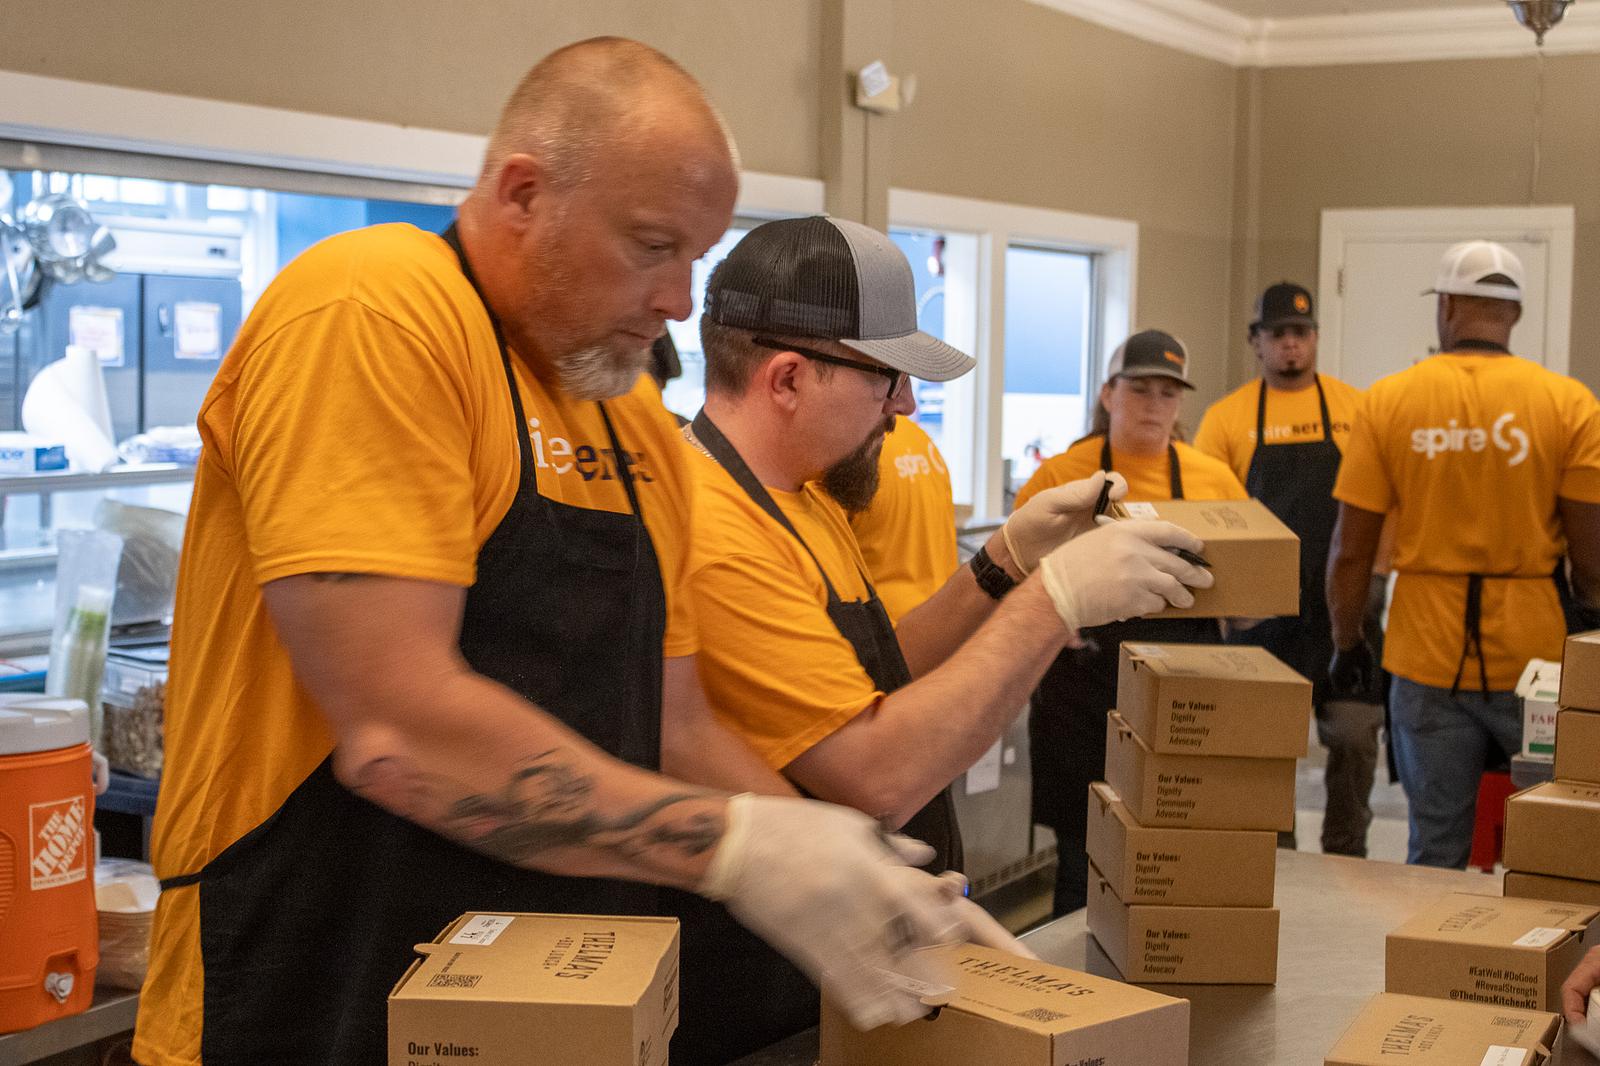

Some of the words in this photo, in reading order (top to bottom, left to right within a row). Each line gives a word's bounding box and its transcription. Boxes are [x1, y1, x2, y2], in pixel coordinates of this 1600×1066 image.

[1411, 419, 1487, 459] spire
[894, 448, 931, 483] spire
[1172, 700, 1185, 710] Our
[1171, 712, 1197, 723] Dignity
[1170, 725, 1210, 737] Community
[1169, 736, 1202, 747] Advocacy
[1158, 774, 1172, 784] Our
[1157, 786, 1182, 796] Dignity
[1156, 798, 1196, 809] Community
[1155, 809, 1189, 820] Advocacy
[38, 809, 63, 842] THE
[31, 799, 83, 878] HOME
[57, 825, 85, 876] DEPOT
[1136, 852, 1150, 861] Our
[1135, 864, 1161, 874] Dignity
[1134, 876, 1175, 888] Community
[1134, 887, 1167, 898] Advocacy
[1146, 928, 1160, 939] Our
[1162, 928, 1191, 940] Values:
[1145, 941, 1170, 952] Dignity
[554, 931, 616, 980] THELMA'S
[1144, 953, 1184, 964] Community
[1143, 964, 1176, 975] Advocacy
[1469, 966, 1502, 980] #EatWell
[1504, 969, 1538, 985] #DoGood
[958, 956, 1096, 997] THELMA'S
[1475, 979, 1538, 998] #RevealStrength
[1449, 988, 1538, 1010] @ThelmasKitchenKC
[1381, 1014, 1435, 1056] THELMA'S
[407, 1041, 431, 1056] Our
[434, 1042, 480, 1058] Values:
